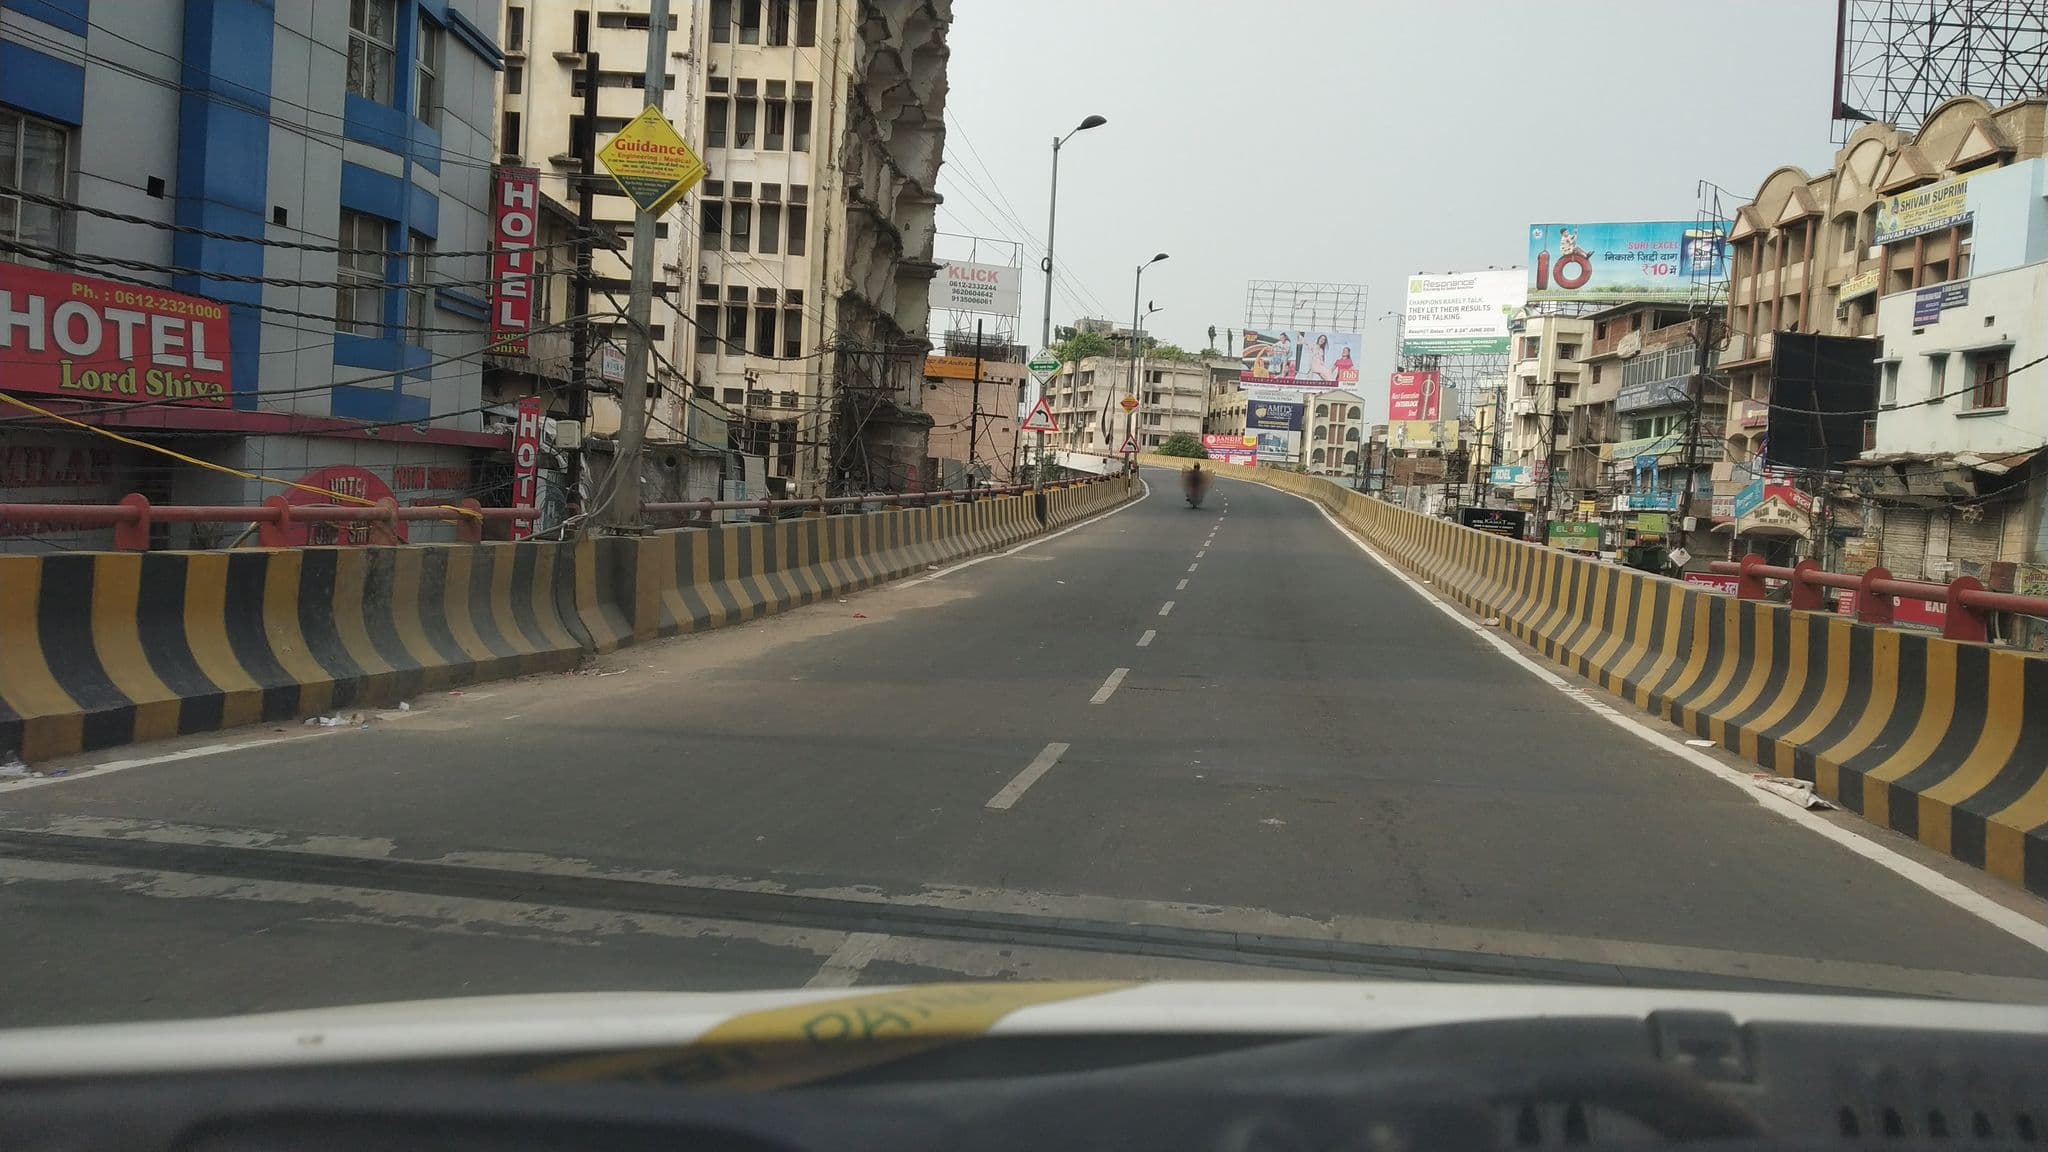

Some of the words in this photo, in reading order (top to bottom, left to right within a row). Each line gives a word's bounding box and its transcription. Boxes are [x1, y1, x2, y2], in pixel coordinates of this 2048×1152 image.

[614, 138, 686, 156] Guidance
[1900, 194, 1931, 212] SHIVAM
[1877, 230, 1905, 242] SHIVAM
[501, 181, 534, 328] HOTEL
[948, 266, 999, 283] KLICK
[114, 290, 222, 320] 0612-2321000
[1409, 306, 1425, 314] THEY
[1440, 305, 1459, 313] THEIR
[0, 290, 224, 372] HOTEL
[60, 359, 138, 395] Lord
[145, 369, 225, 402] Shiva
[1342, 371, 1357, 379] fbb
[1267, 404, 1293, 413] AMITY
